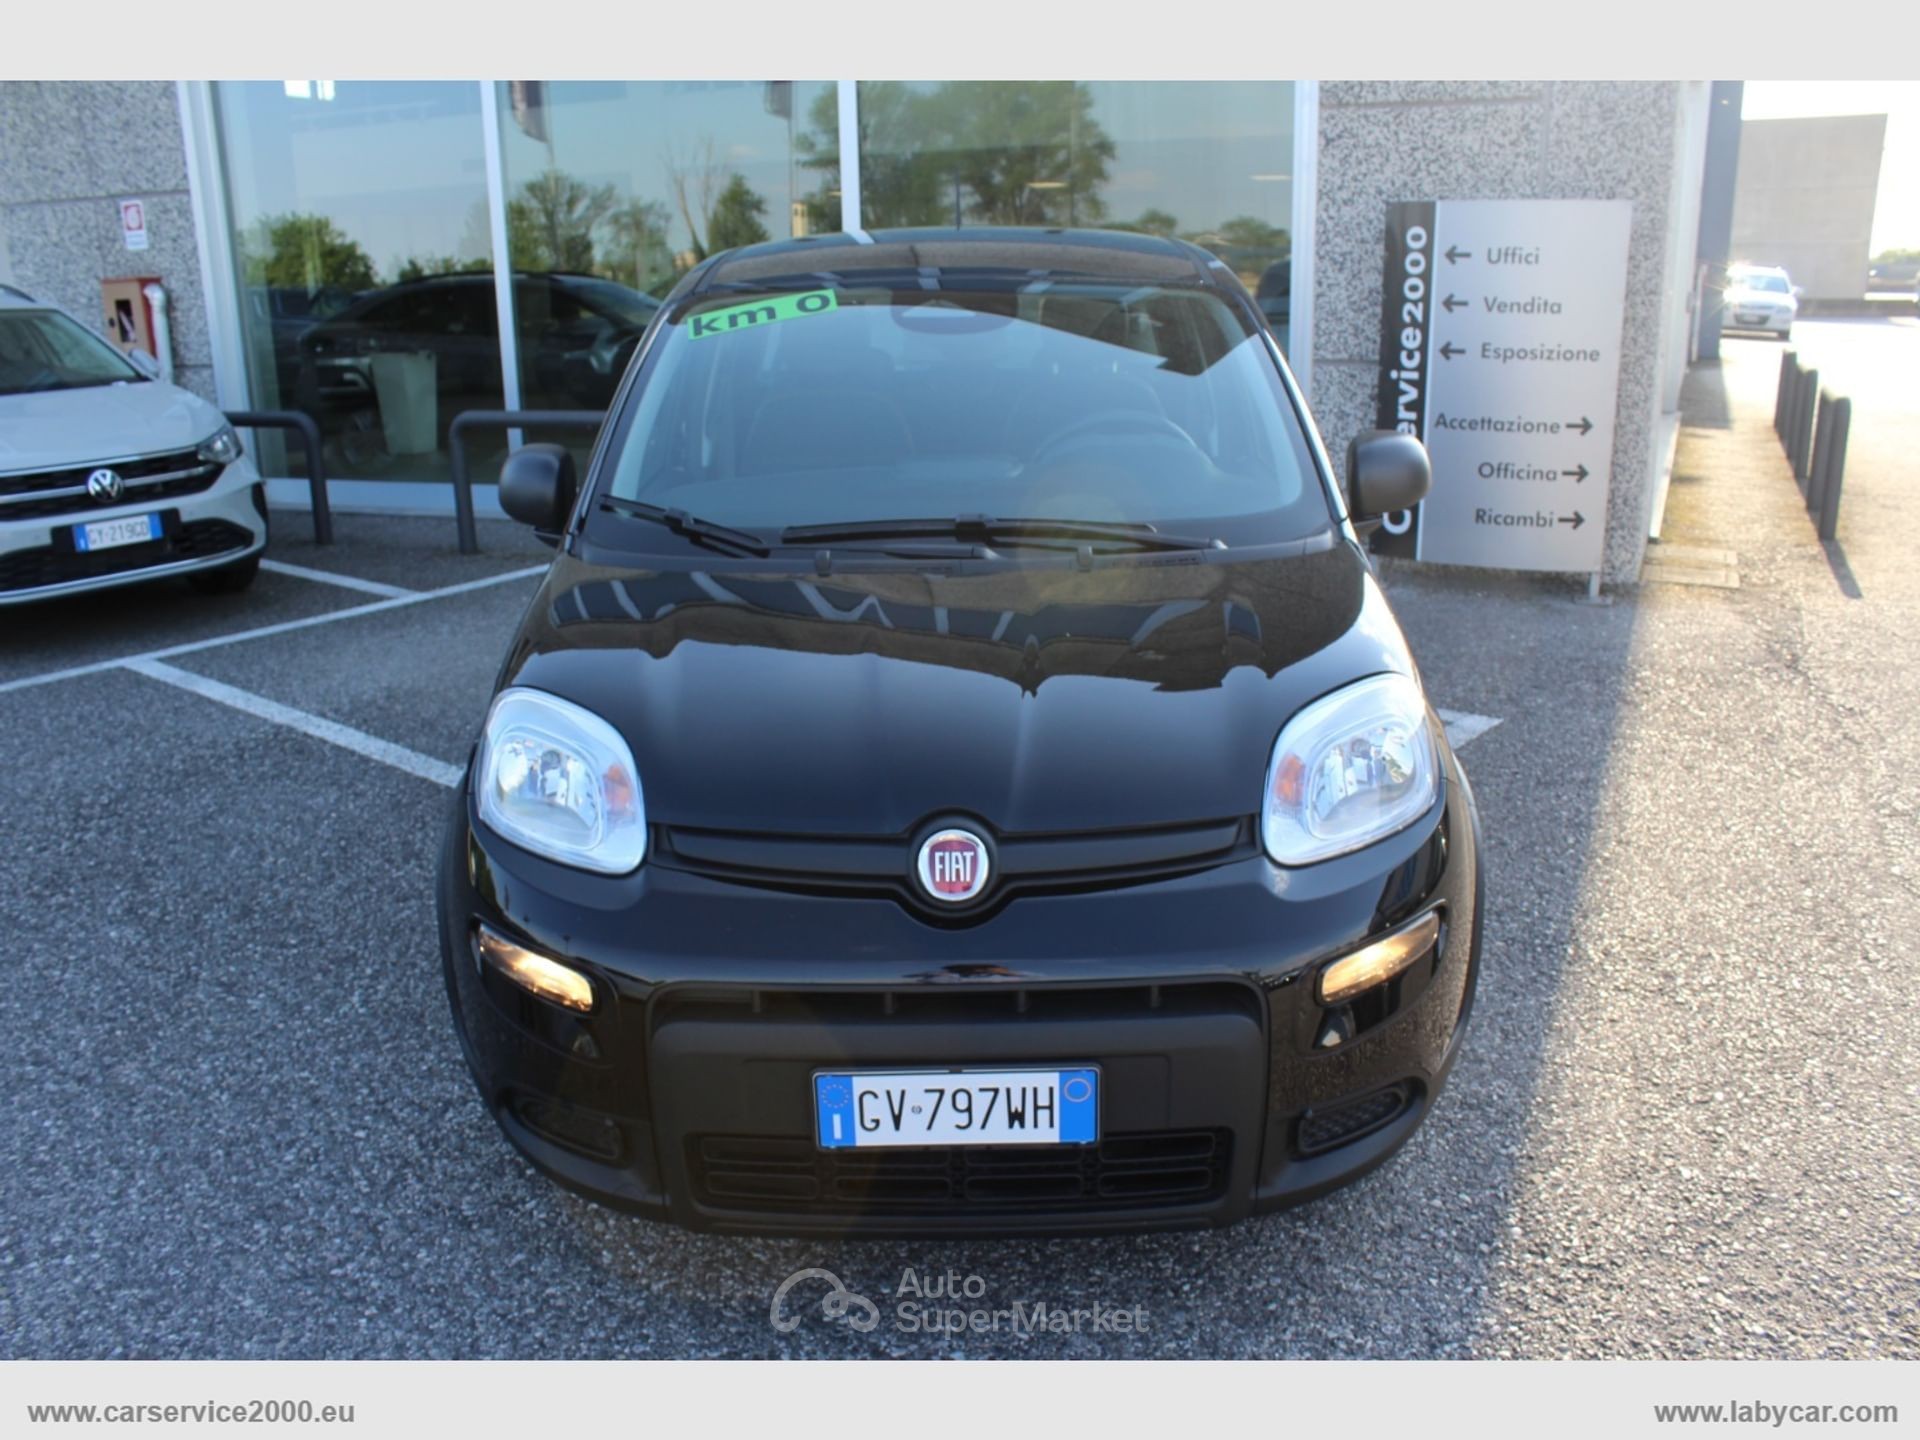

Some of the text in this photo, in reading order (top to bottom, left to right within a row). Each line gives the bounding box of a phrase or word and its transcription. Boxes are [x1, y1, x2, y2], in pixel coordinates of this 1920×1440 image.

[1486, 247, 1541, 265] Uffici
[1483, 296, 1563, 314] Vendita
[692, 305, 777, 337] km
[1480, 342, 1601, 364] Esposizione
[1434, 413, 1561, 434] Accettazione
[1477, 462, 1558, 482] Officina
[1474, 508, 1554, 528] Ricambi
[934, 851, 975, 883] FIAT
